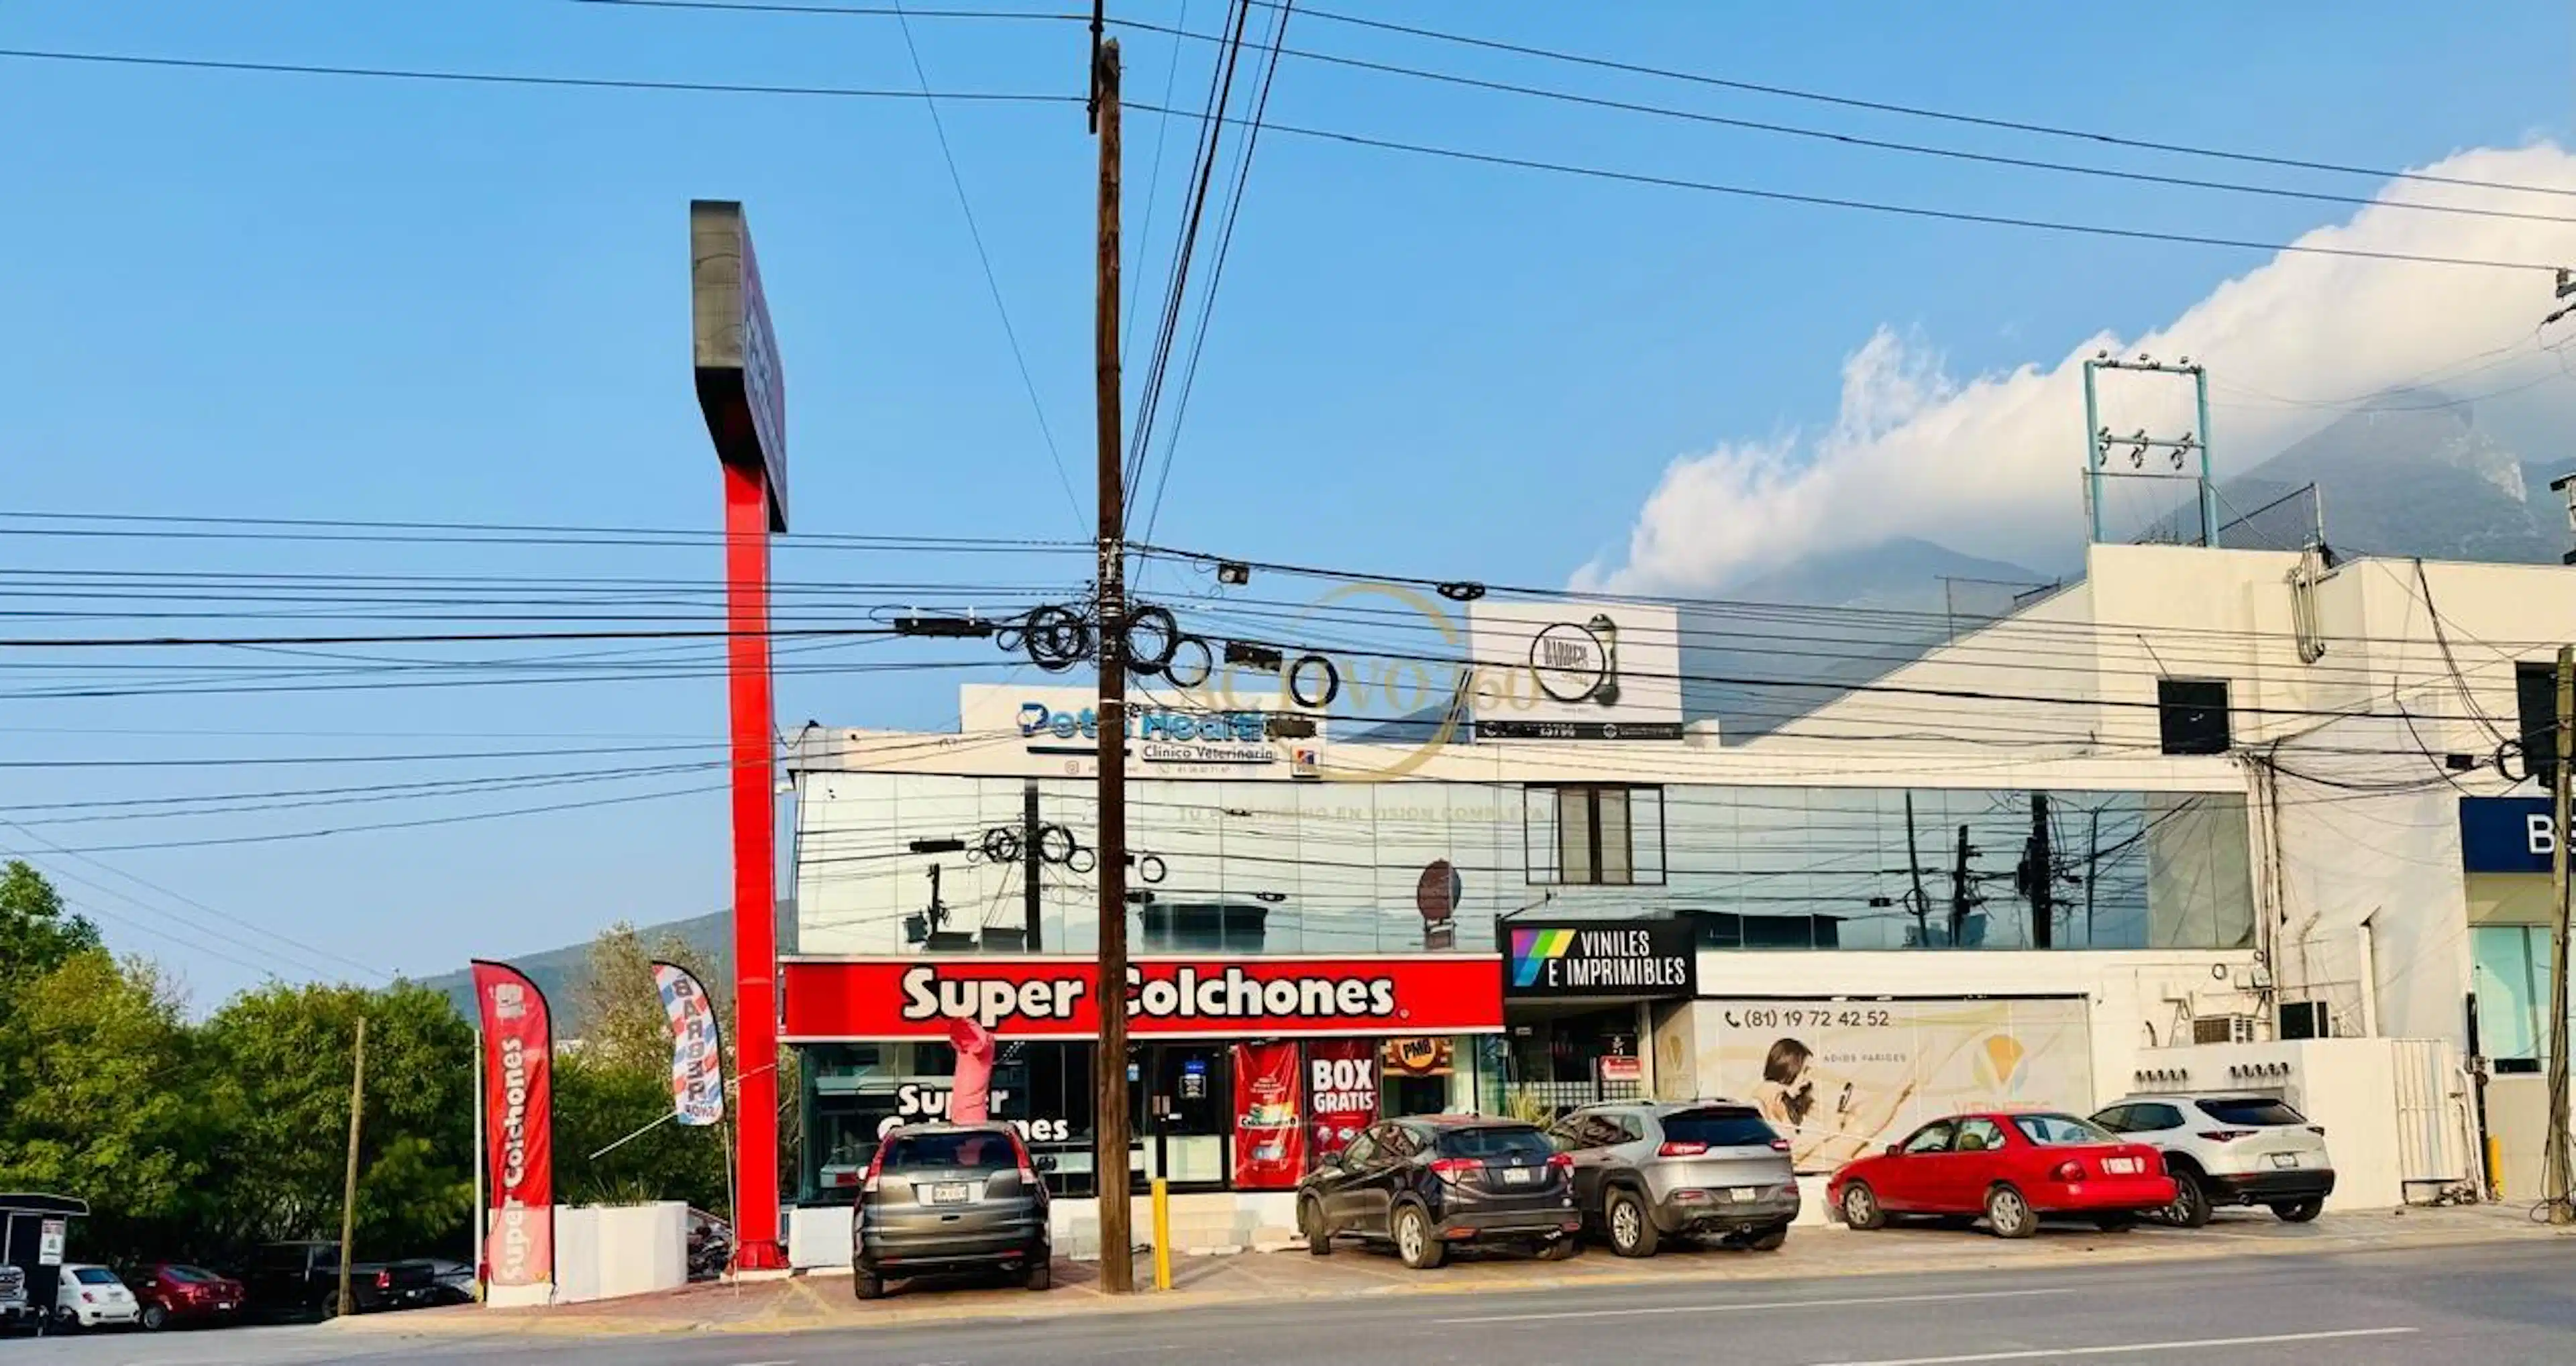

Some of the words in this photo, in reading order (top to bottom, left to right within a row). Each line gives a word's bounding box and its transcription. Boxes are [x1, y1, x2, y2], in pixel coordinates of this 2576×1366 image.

[1580, 930, 1650, 957] VINILES
[1548, 958, 1560, 987] E
[1566, 957, 1686, 987] IMPRIMIBLES
[902, 966, 1085, 1027] Super
[1744, 1009, 1777, 1028] (81)
[1784, 1010, 1803, 1027] 19
[1809, 1011, 1832, 1027] 72
[1838, 1011, 1861, 1027] 42
[1867, 1010, 1890, 1027] 52
[1312, 1059, 1373, 1091] BOX
[898, 1085, 1009, 1120] Sur
[1313, 1091, 1375, 1113] GRATIS
